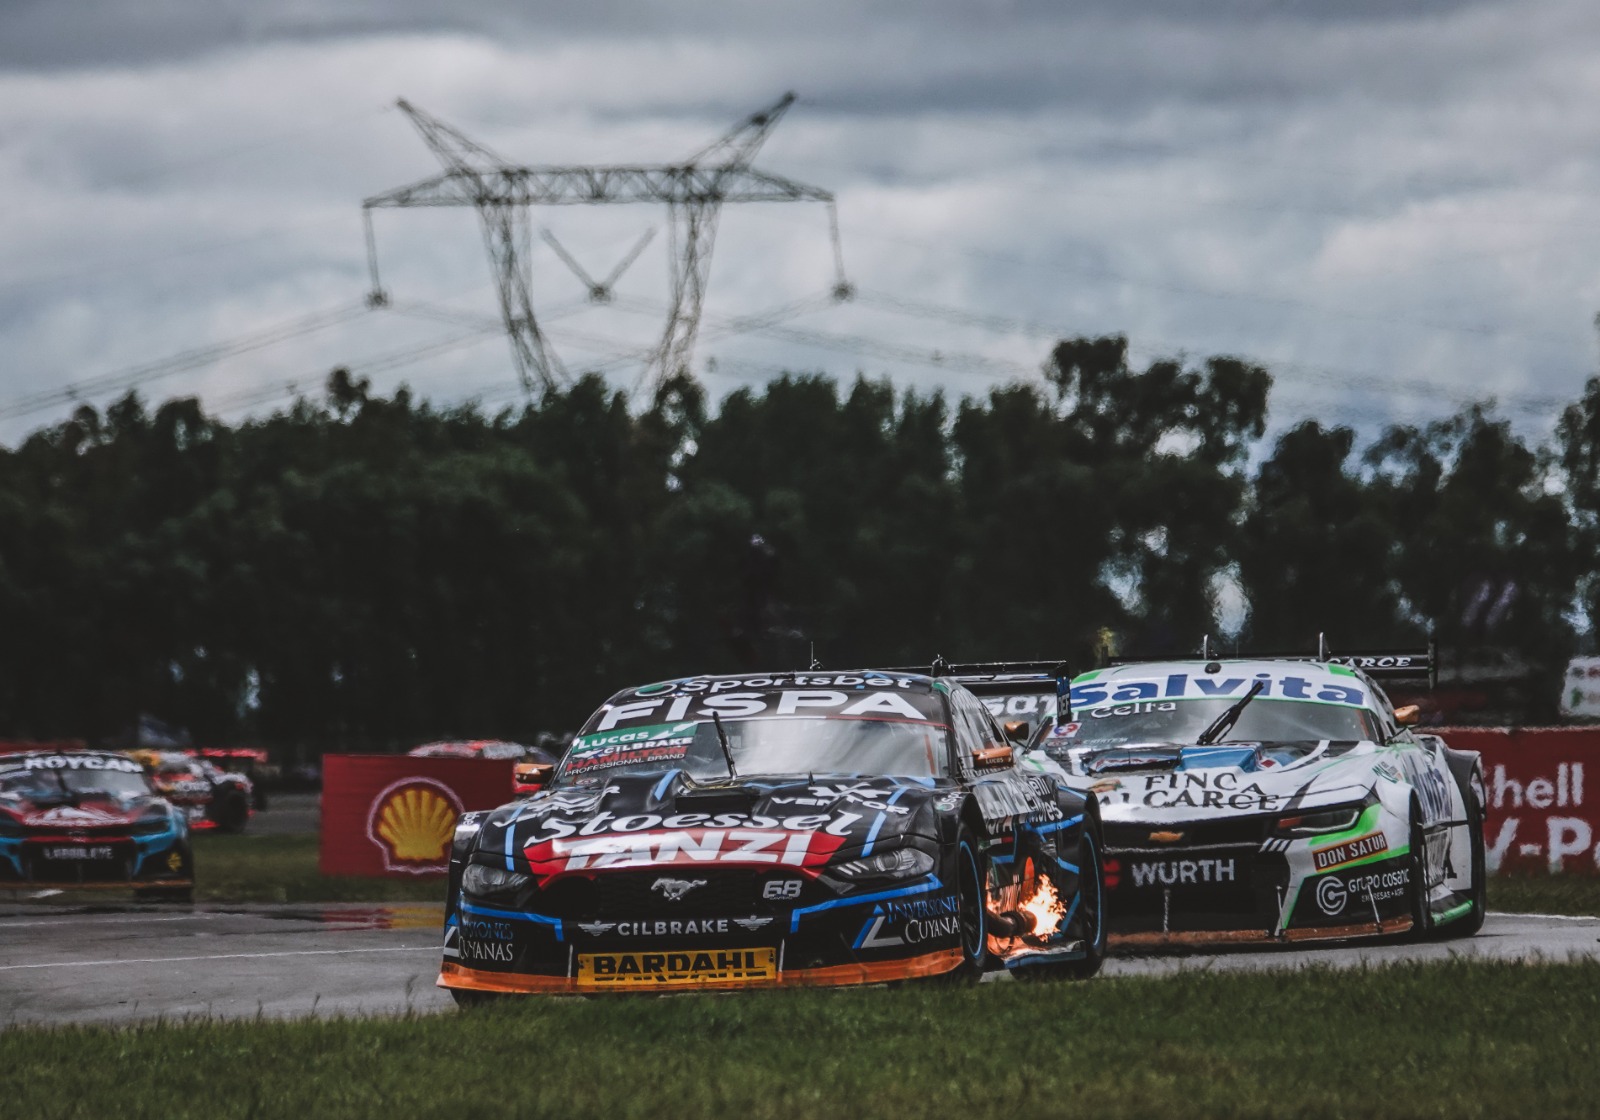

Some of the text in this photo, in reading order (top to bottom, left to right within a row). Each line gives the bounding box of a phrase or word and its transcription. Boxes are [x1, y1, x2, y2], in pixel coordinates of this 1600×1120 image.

[681, 675, 913, 693] Sportsbet
[1070, 673, 1364, 706] Salvita
[597, 690, 928, 731] FISPA
[577, 731, 649, 749] Lucas
[604, 737, 694, 754] CILBRAKE
[565, 753, 685, 776] PROFESSIONAL BRAND
[566, 746, 687, 771] HAMILTON
[1145, 772, 1267, 797] FINCA
[1484, 763, 1584, 809] hell
[524, 809, 863, 848] Stoessel
[552, 831, 814, 870] TANZI
[1317, 833, 1387, 868] DON SATUR
[763, 880, 802, 899] 68
[617, 919, 729, 936] CILBRAKE
[593, 951, 767, 982] BARDAHL
